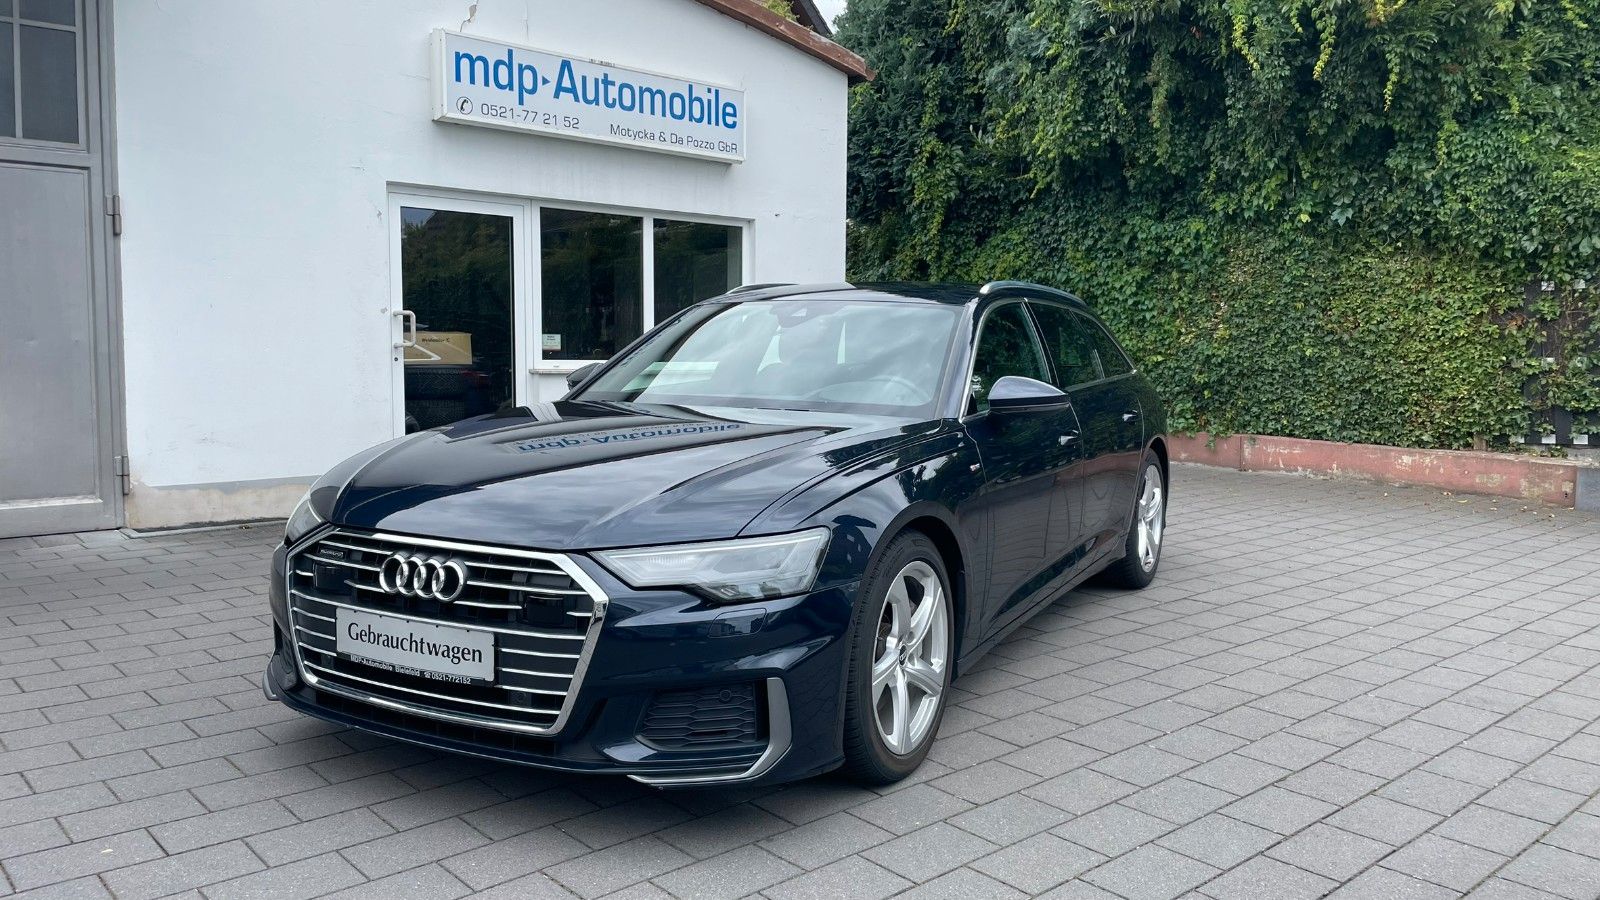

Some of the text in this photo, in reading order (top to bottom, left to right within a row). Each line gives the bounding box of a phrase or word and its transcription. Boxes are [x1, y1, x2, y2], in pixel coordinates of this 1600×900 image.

[454, 48, 738, 129] mdp Automobile
[481, 103, 580, 129] 0521-77 21 52
[610, 123, 738, 154] Motycka & Da Pozzo GbR
[347, 622, 483, 665] Gebrauchtwagen
